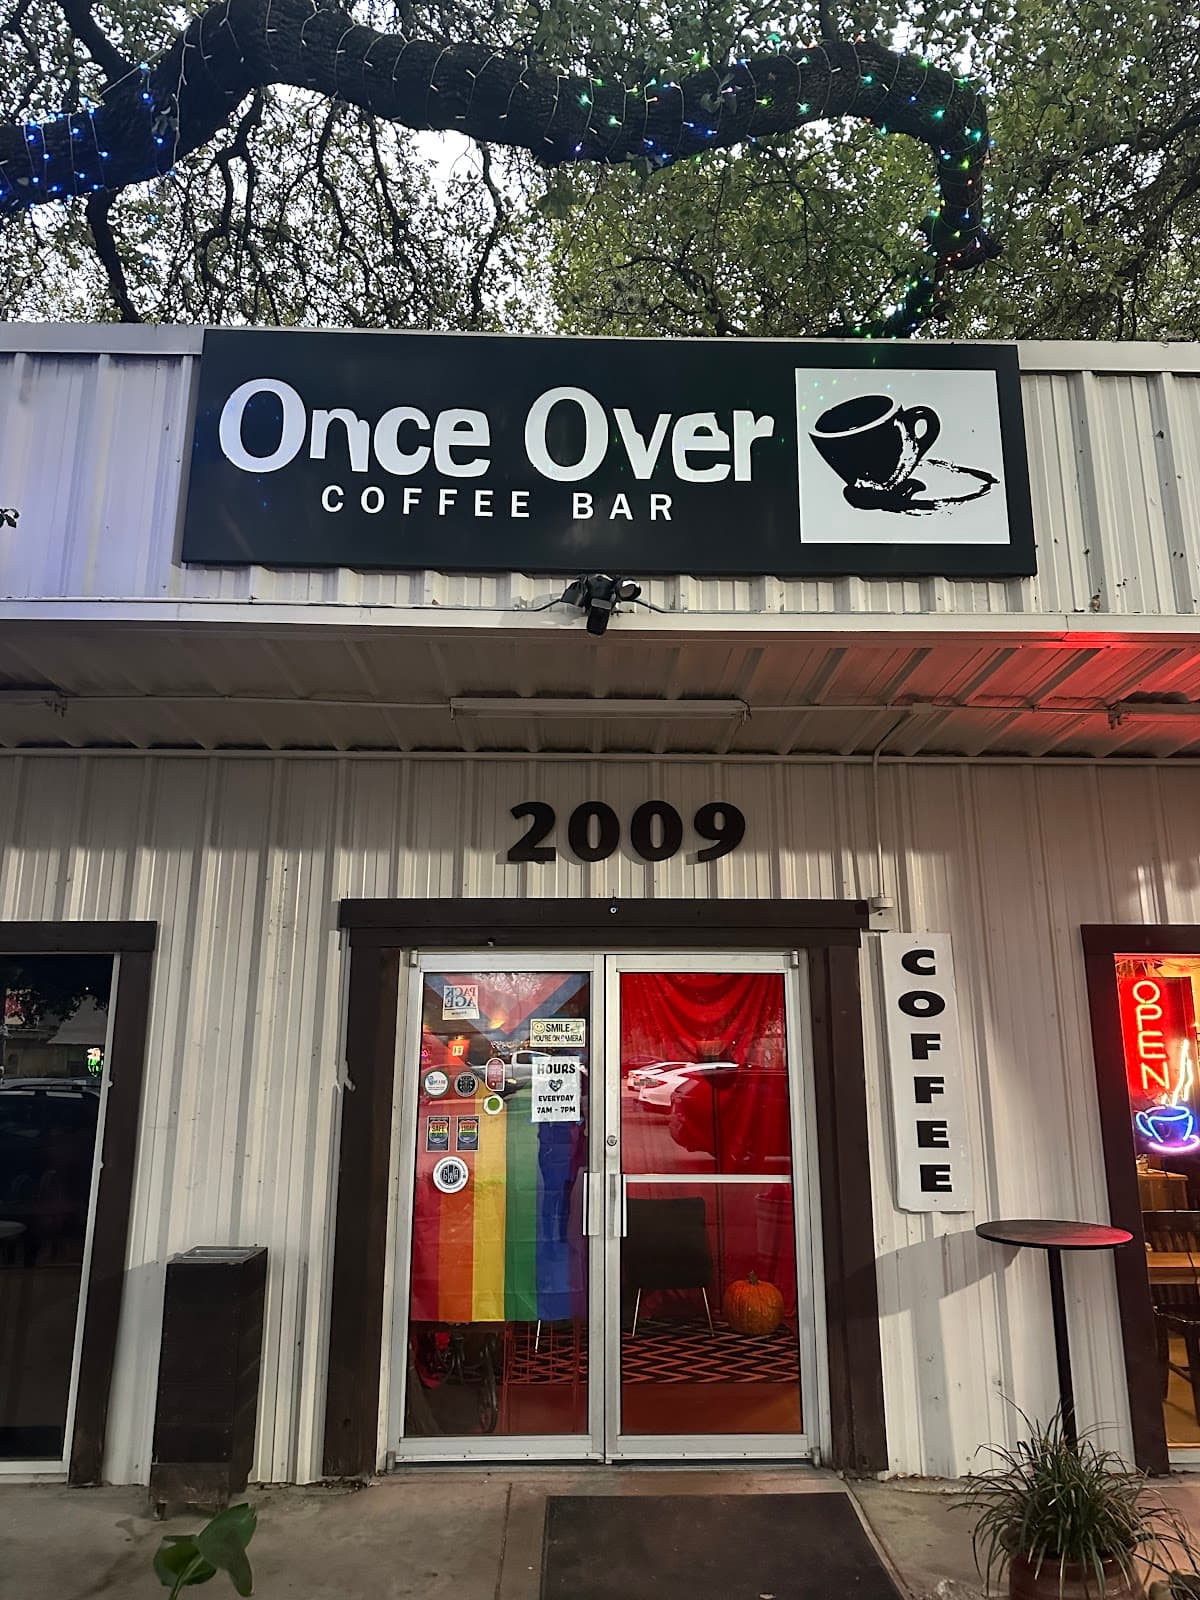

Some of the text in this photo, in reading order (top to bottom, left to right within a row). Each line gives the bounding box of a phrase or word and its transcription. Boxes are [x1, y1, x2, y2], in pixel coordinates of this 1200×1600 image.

[218, 378, 775, 482] Once Over
[321, 484, 674, 521] COFFEE BAR
[507, 799, 746, 863] 2009
[1131, 979, 1171, 1090] OPEN
[537, 1063, 576, 1074] HOURS
[897, 948, 953, 1193] COFFEE
[536, 1106, 553, 1114] 7AM
[538, 1094, 575, 1102] EVERYDAY
